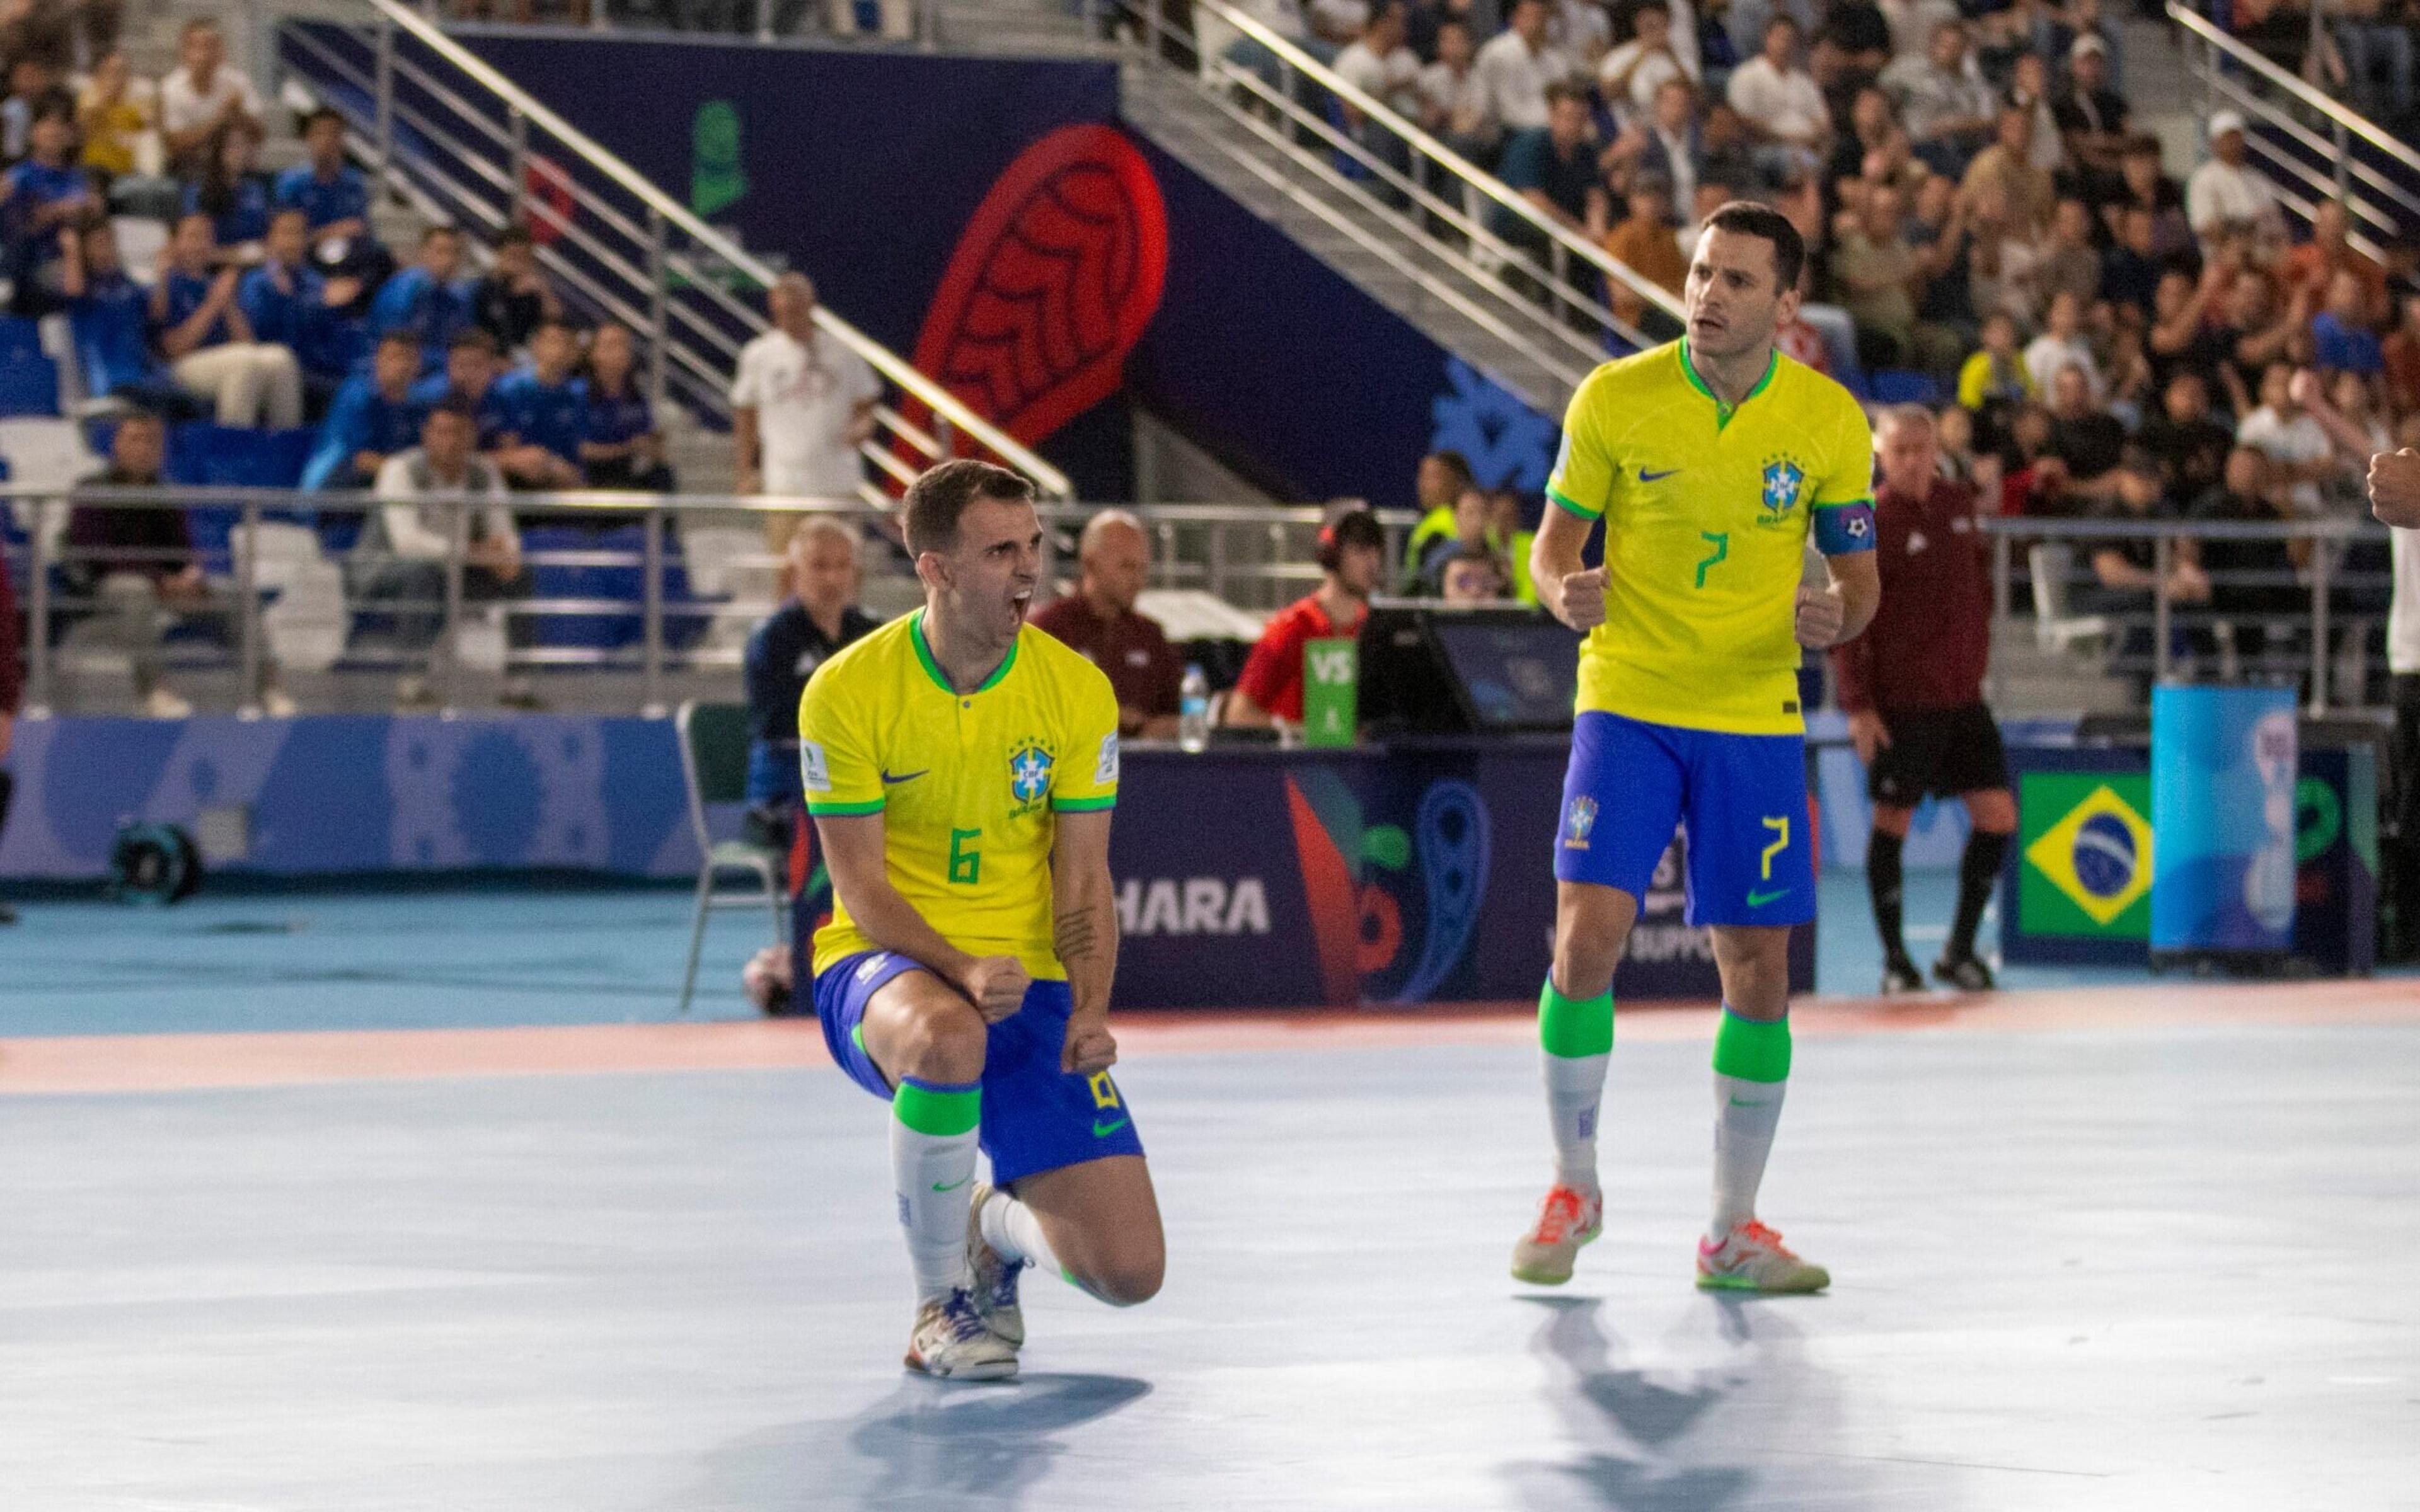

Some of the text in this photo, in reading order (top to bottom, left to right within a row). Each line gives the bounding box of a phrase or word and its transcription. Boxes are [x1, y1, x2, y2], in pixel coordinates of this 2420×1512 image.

[1695, 530, 1729, 589] 7
[1309, 651, 1352, 685] VS
[948, 827, 982, 885] 6
[1761, 816, 1789, 880] 7
